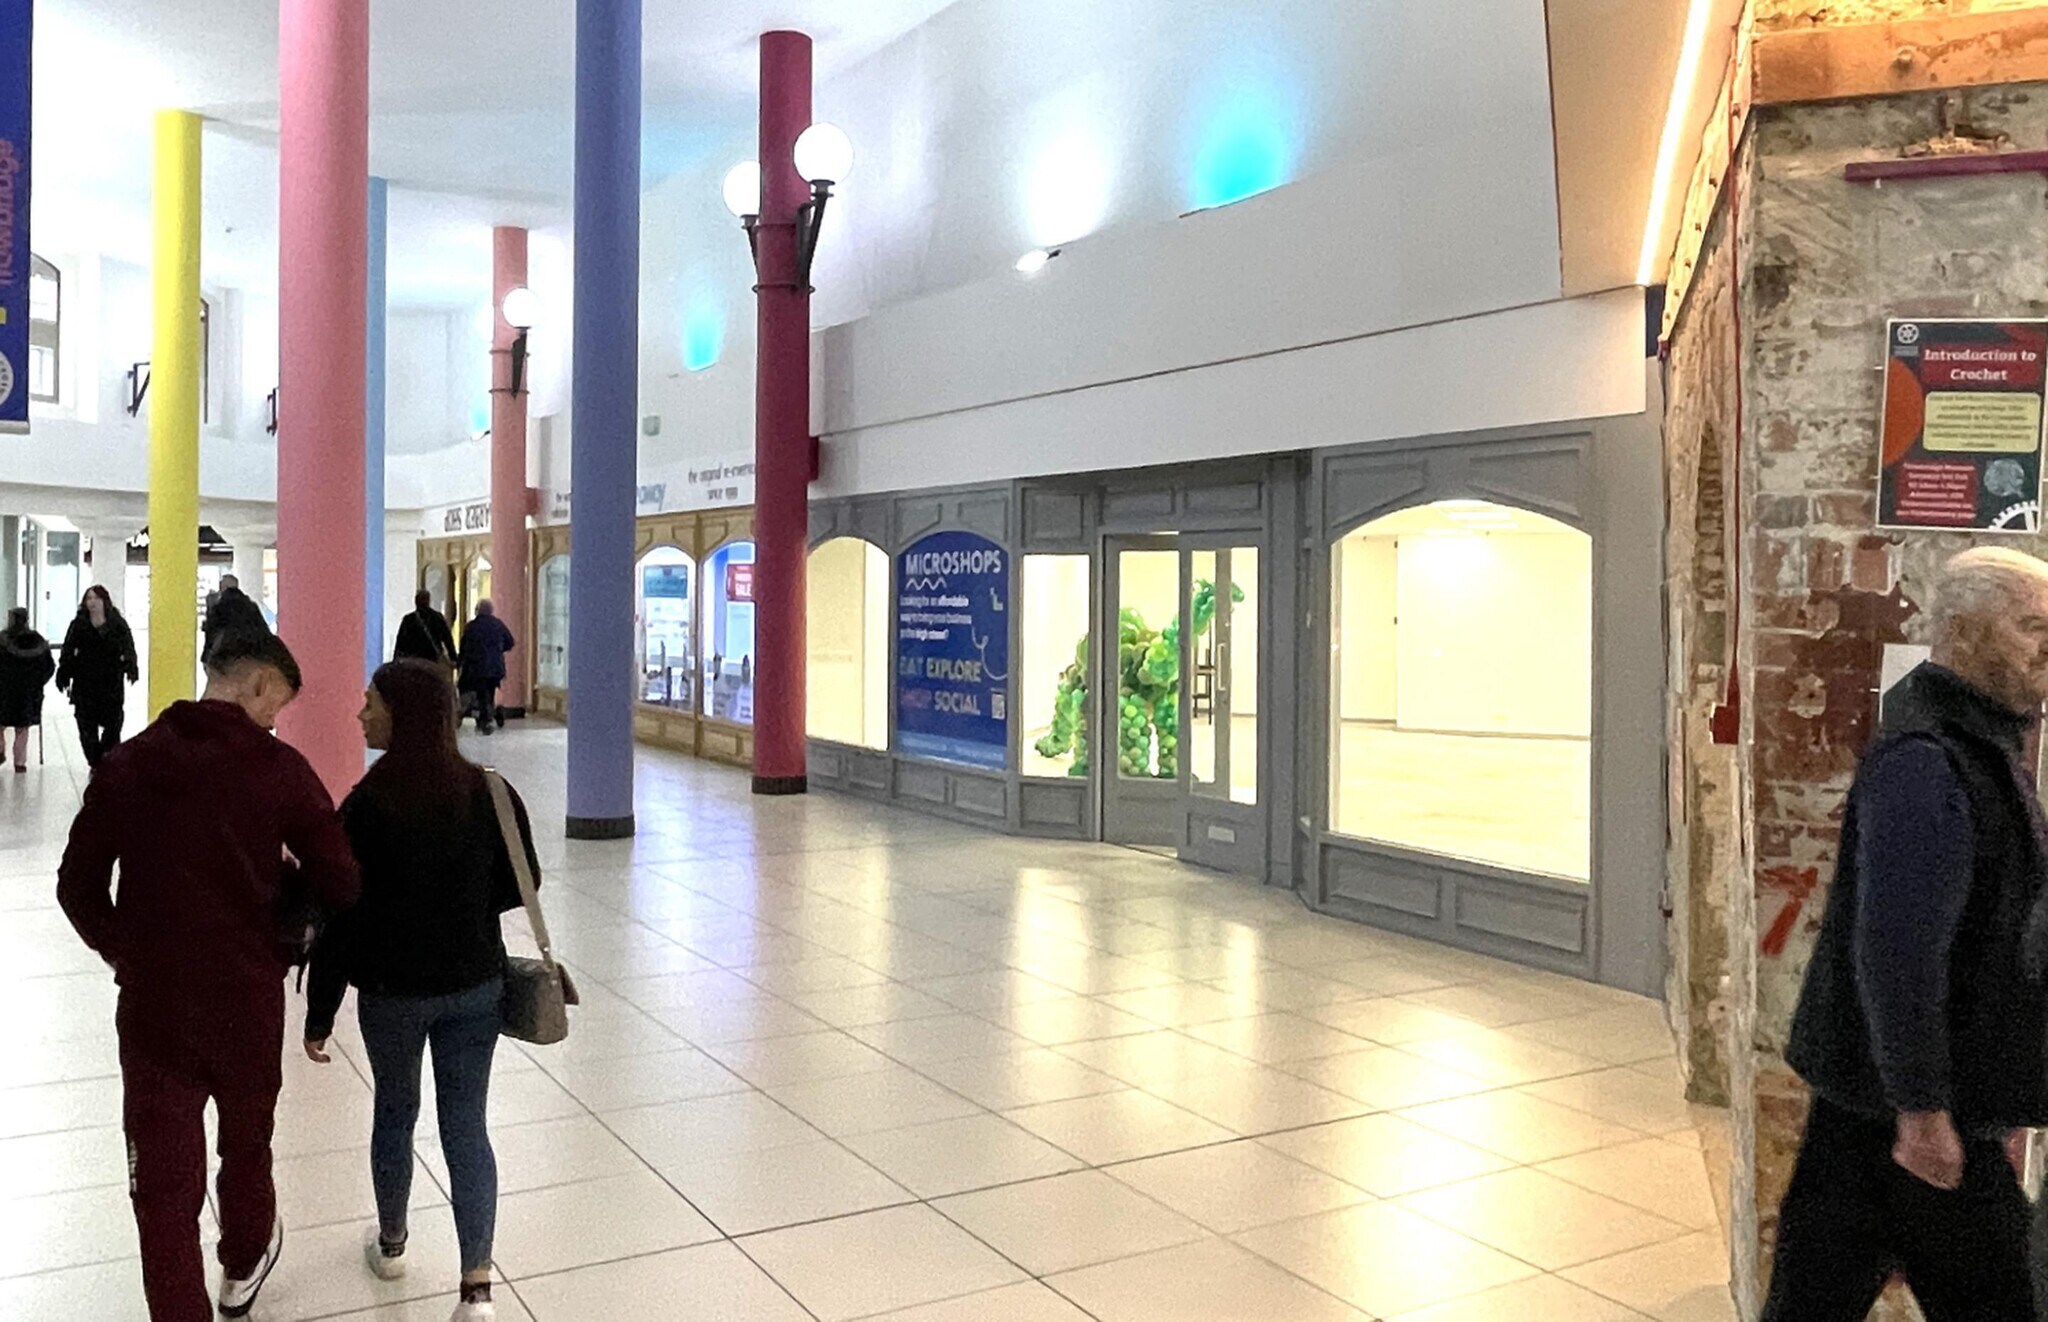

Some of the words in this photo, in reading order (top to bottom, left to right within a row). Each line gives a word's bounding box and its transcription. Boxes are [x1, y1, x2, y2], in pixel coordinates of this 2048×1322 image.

[1924, 348, 2018, 362] Introduction
[2021, 349, 2037, 362] to
[1950, 367, 2008, 380] Crochet
[905, 549, 1002, 575] MICROSHOPS
[926, 656, 981, 682] EXPLORE
[934, 690, 980, 716] SOCIAL
